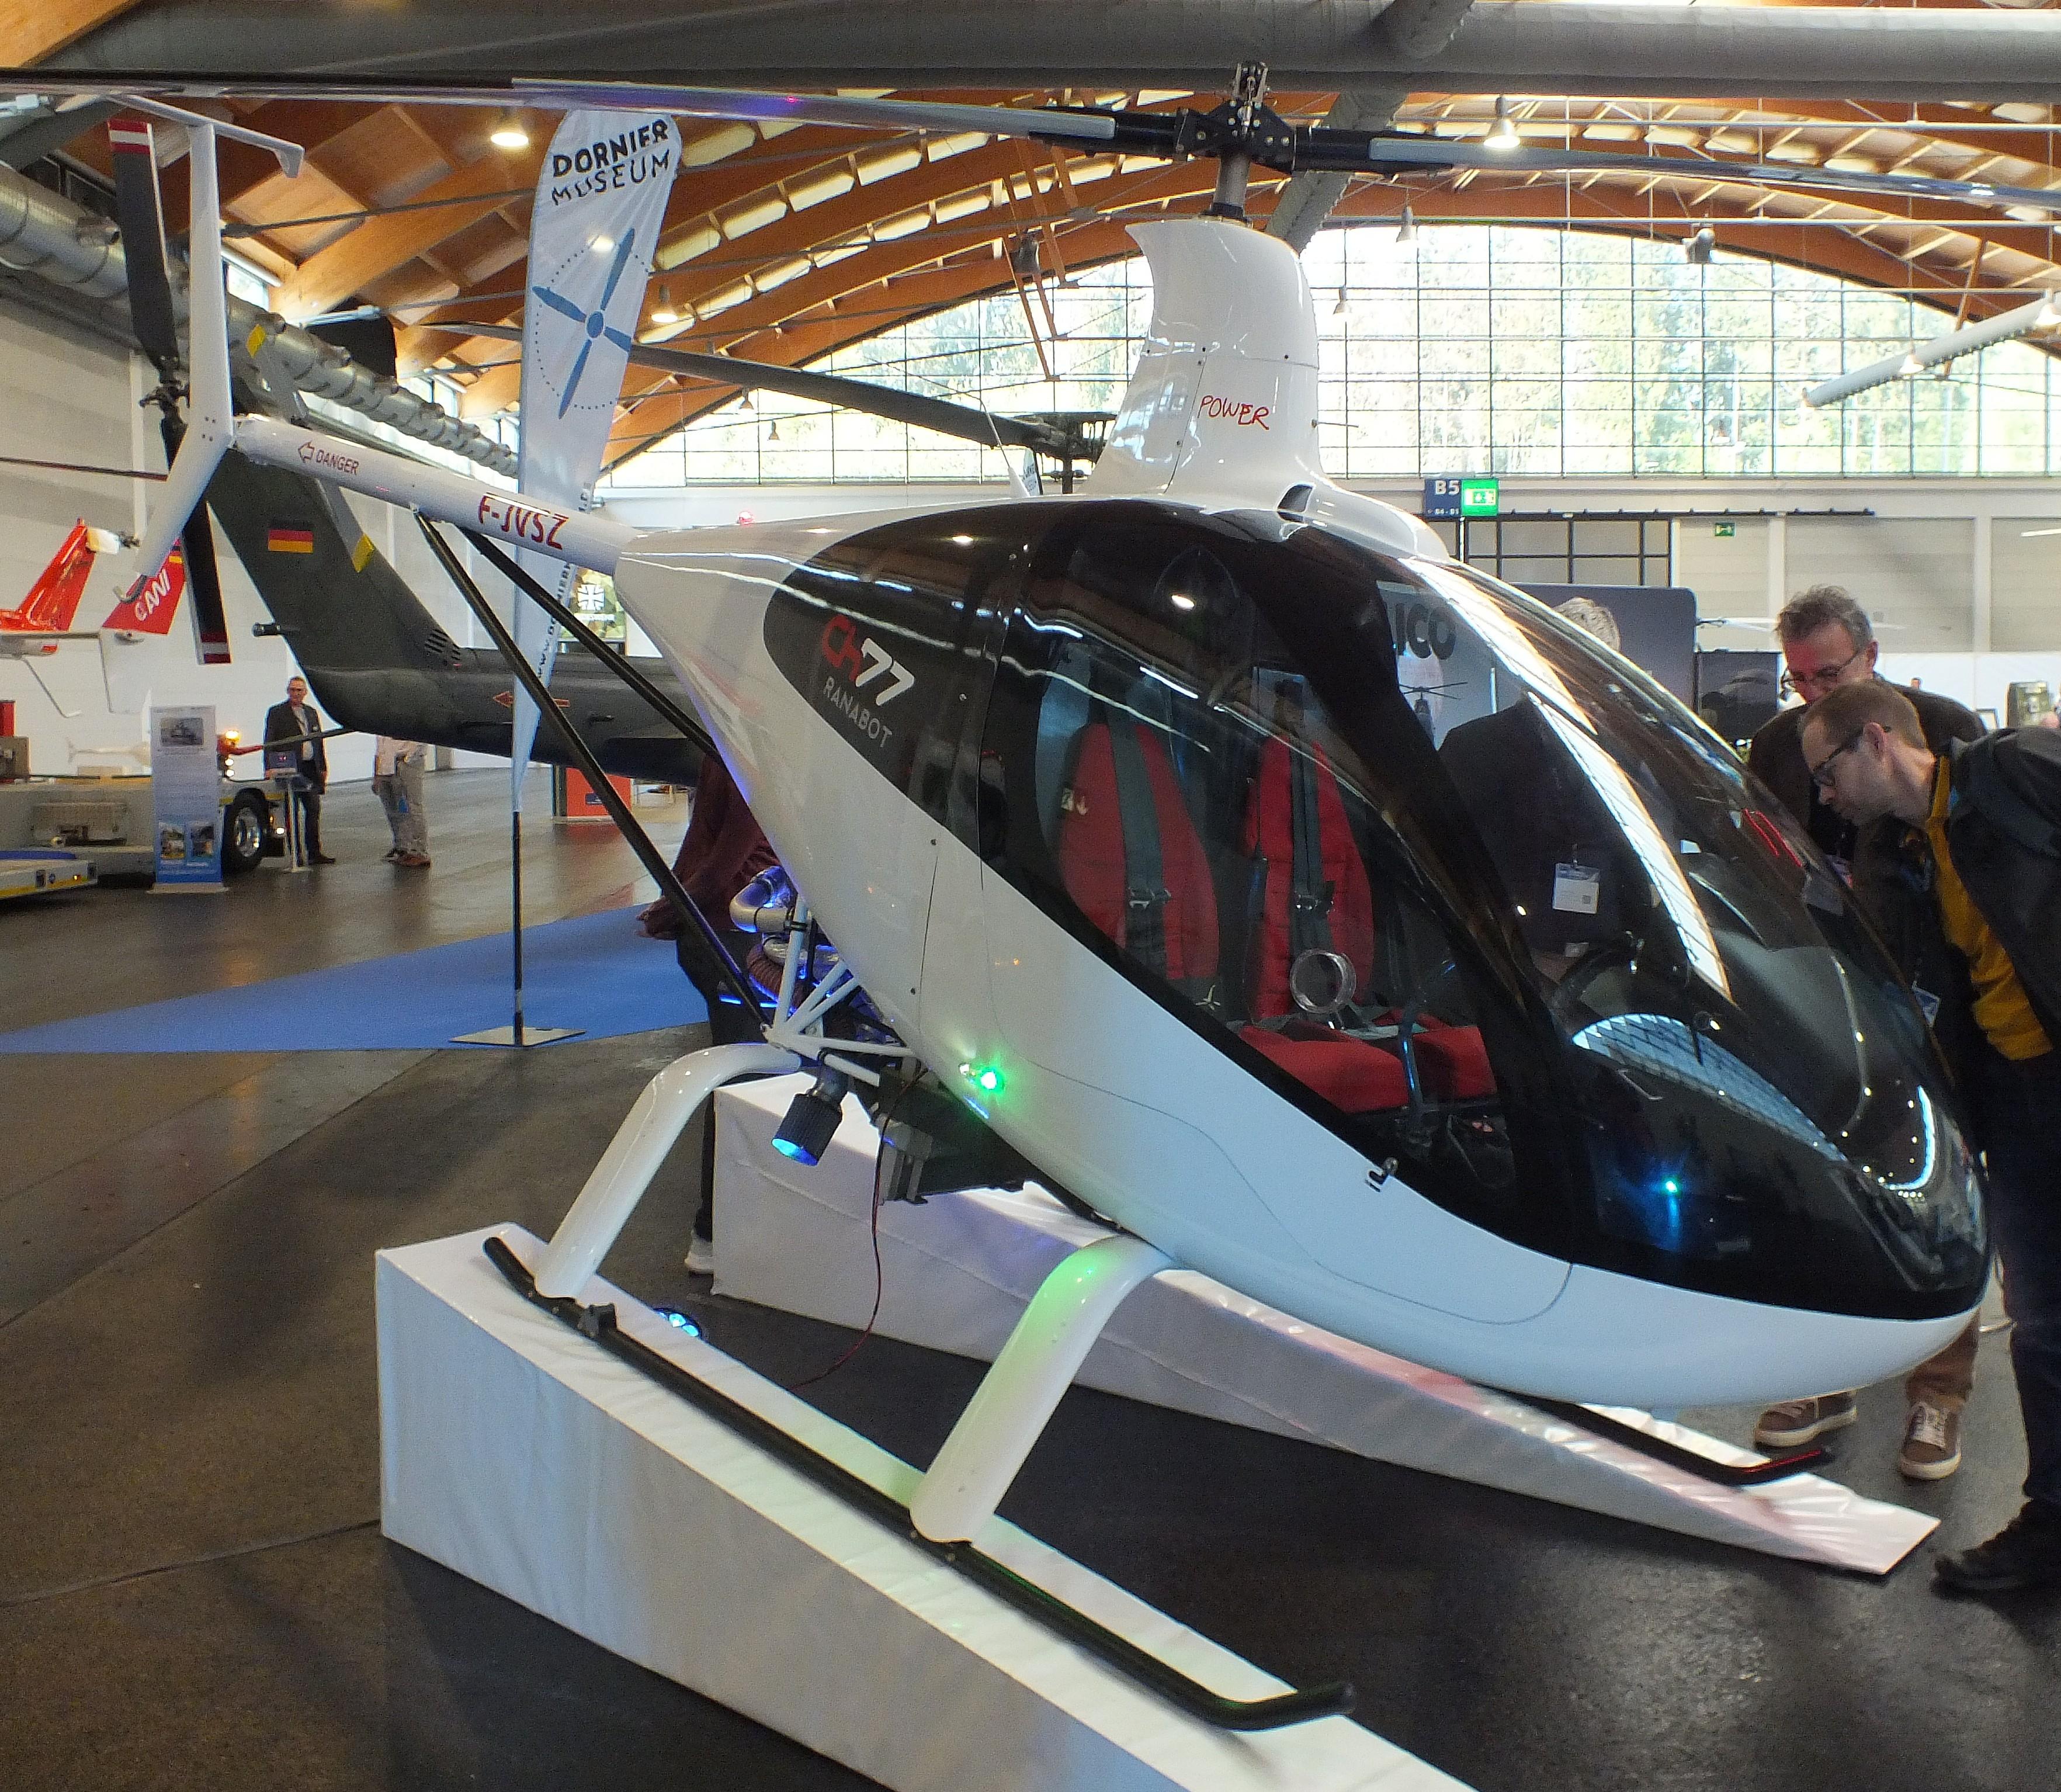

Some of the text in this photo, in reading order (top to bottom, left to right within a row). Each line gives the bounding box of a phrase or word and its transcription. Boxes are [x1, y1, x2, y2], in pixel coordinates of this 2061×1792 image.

[551, 148, 670, 206] MUSEUM
[552, 119, 668, 178] DORNIER
[1198, 395, 1270, 430] POWER
[316, 449, 360, 476] DANGER
[1435, 480, 1460, 495] B5
[478, 492, 570, 550] F-JVSZ
[823, 675, 893, 748] RANABOT
